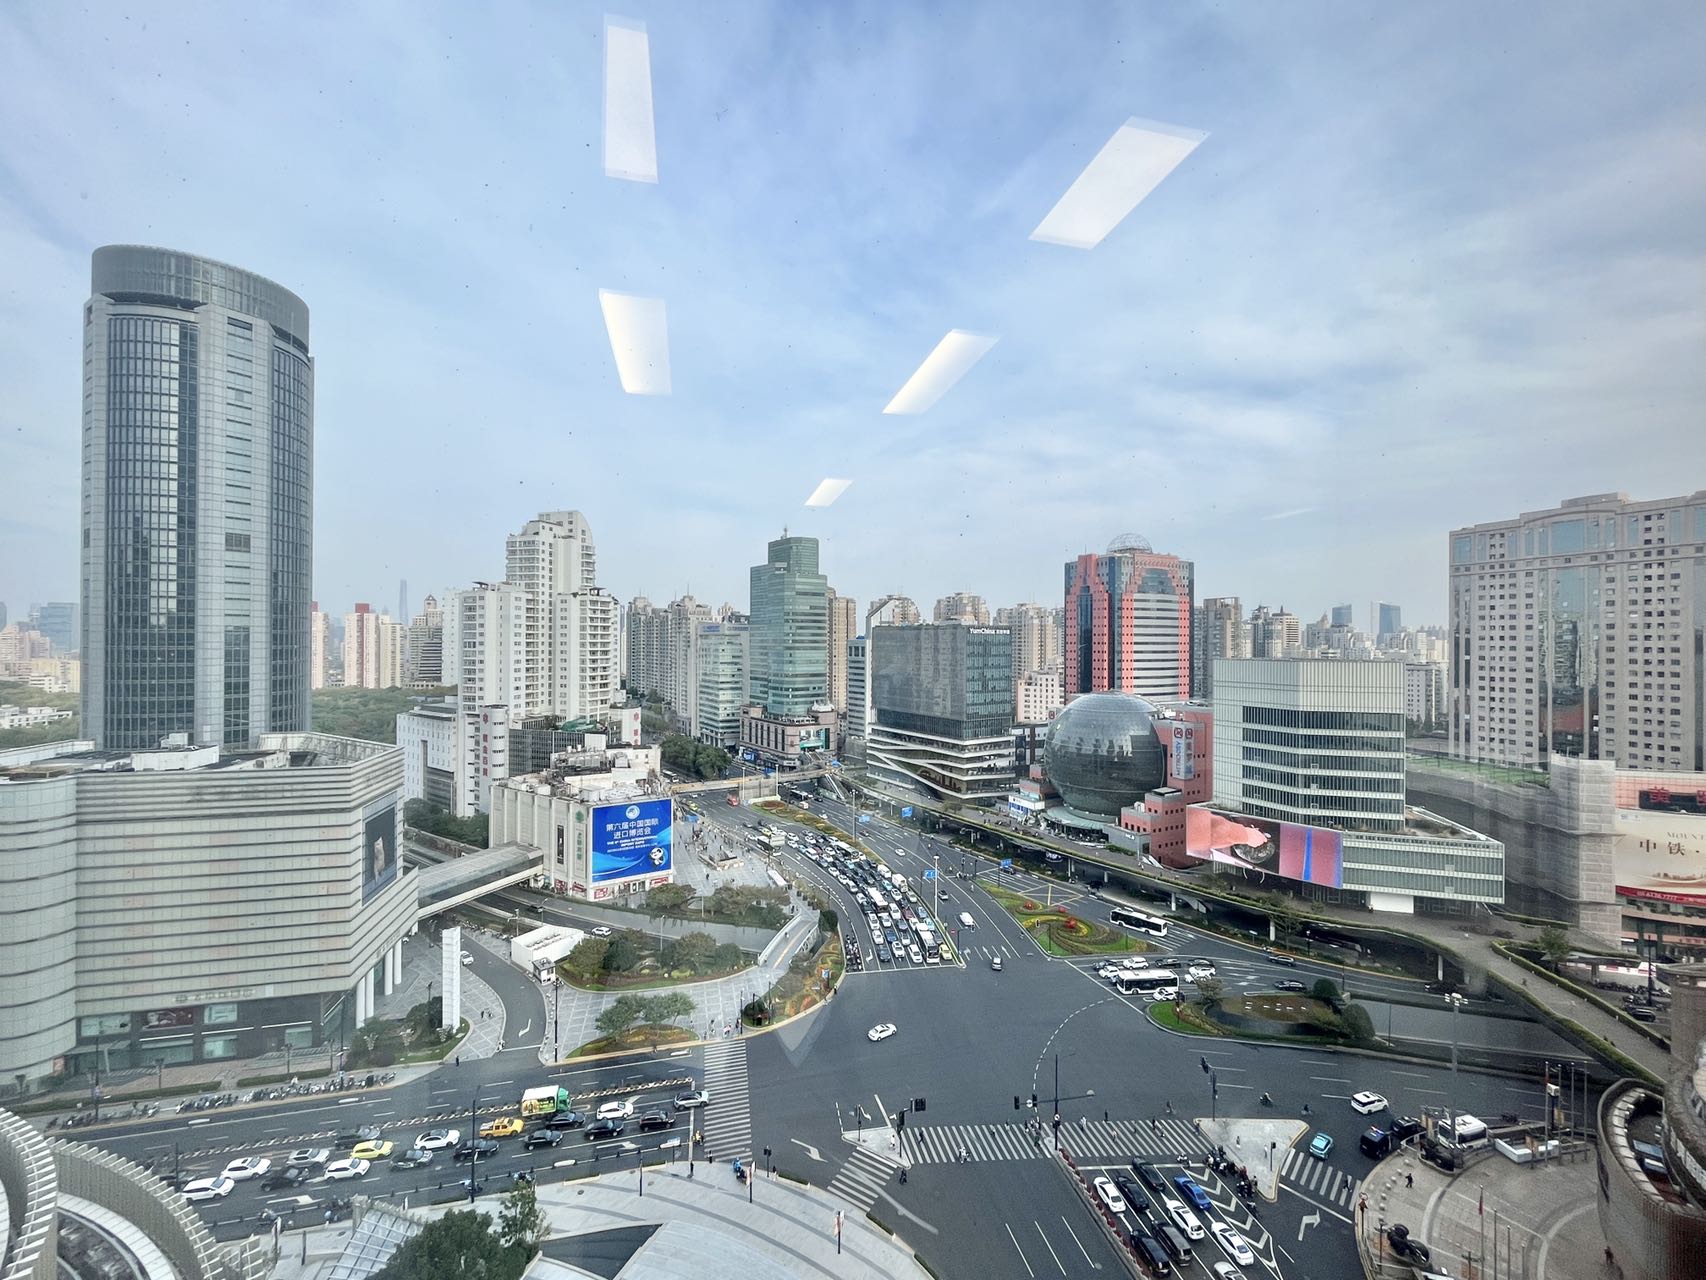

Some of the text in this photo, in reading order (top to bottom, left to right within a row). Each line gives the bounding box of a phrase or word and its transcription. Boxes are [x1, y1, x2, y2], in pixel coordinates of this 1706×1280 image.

[606, 818, 658, 831] 第六届中国国际
[614, 827, 651, 839] 进口博览会
